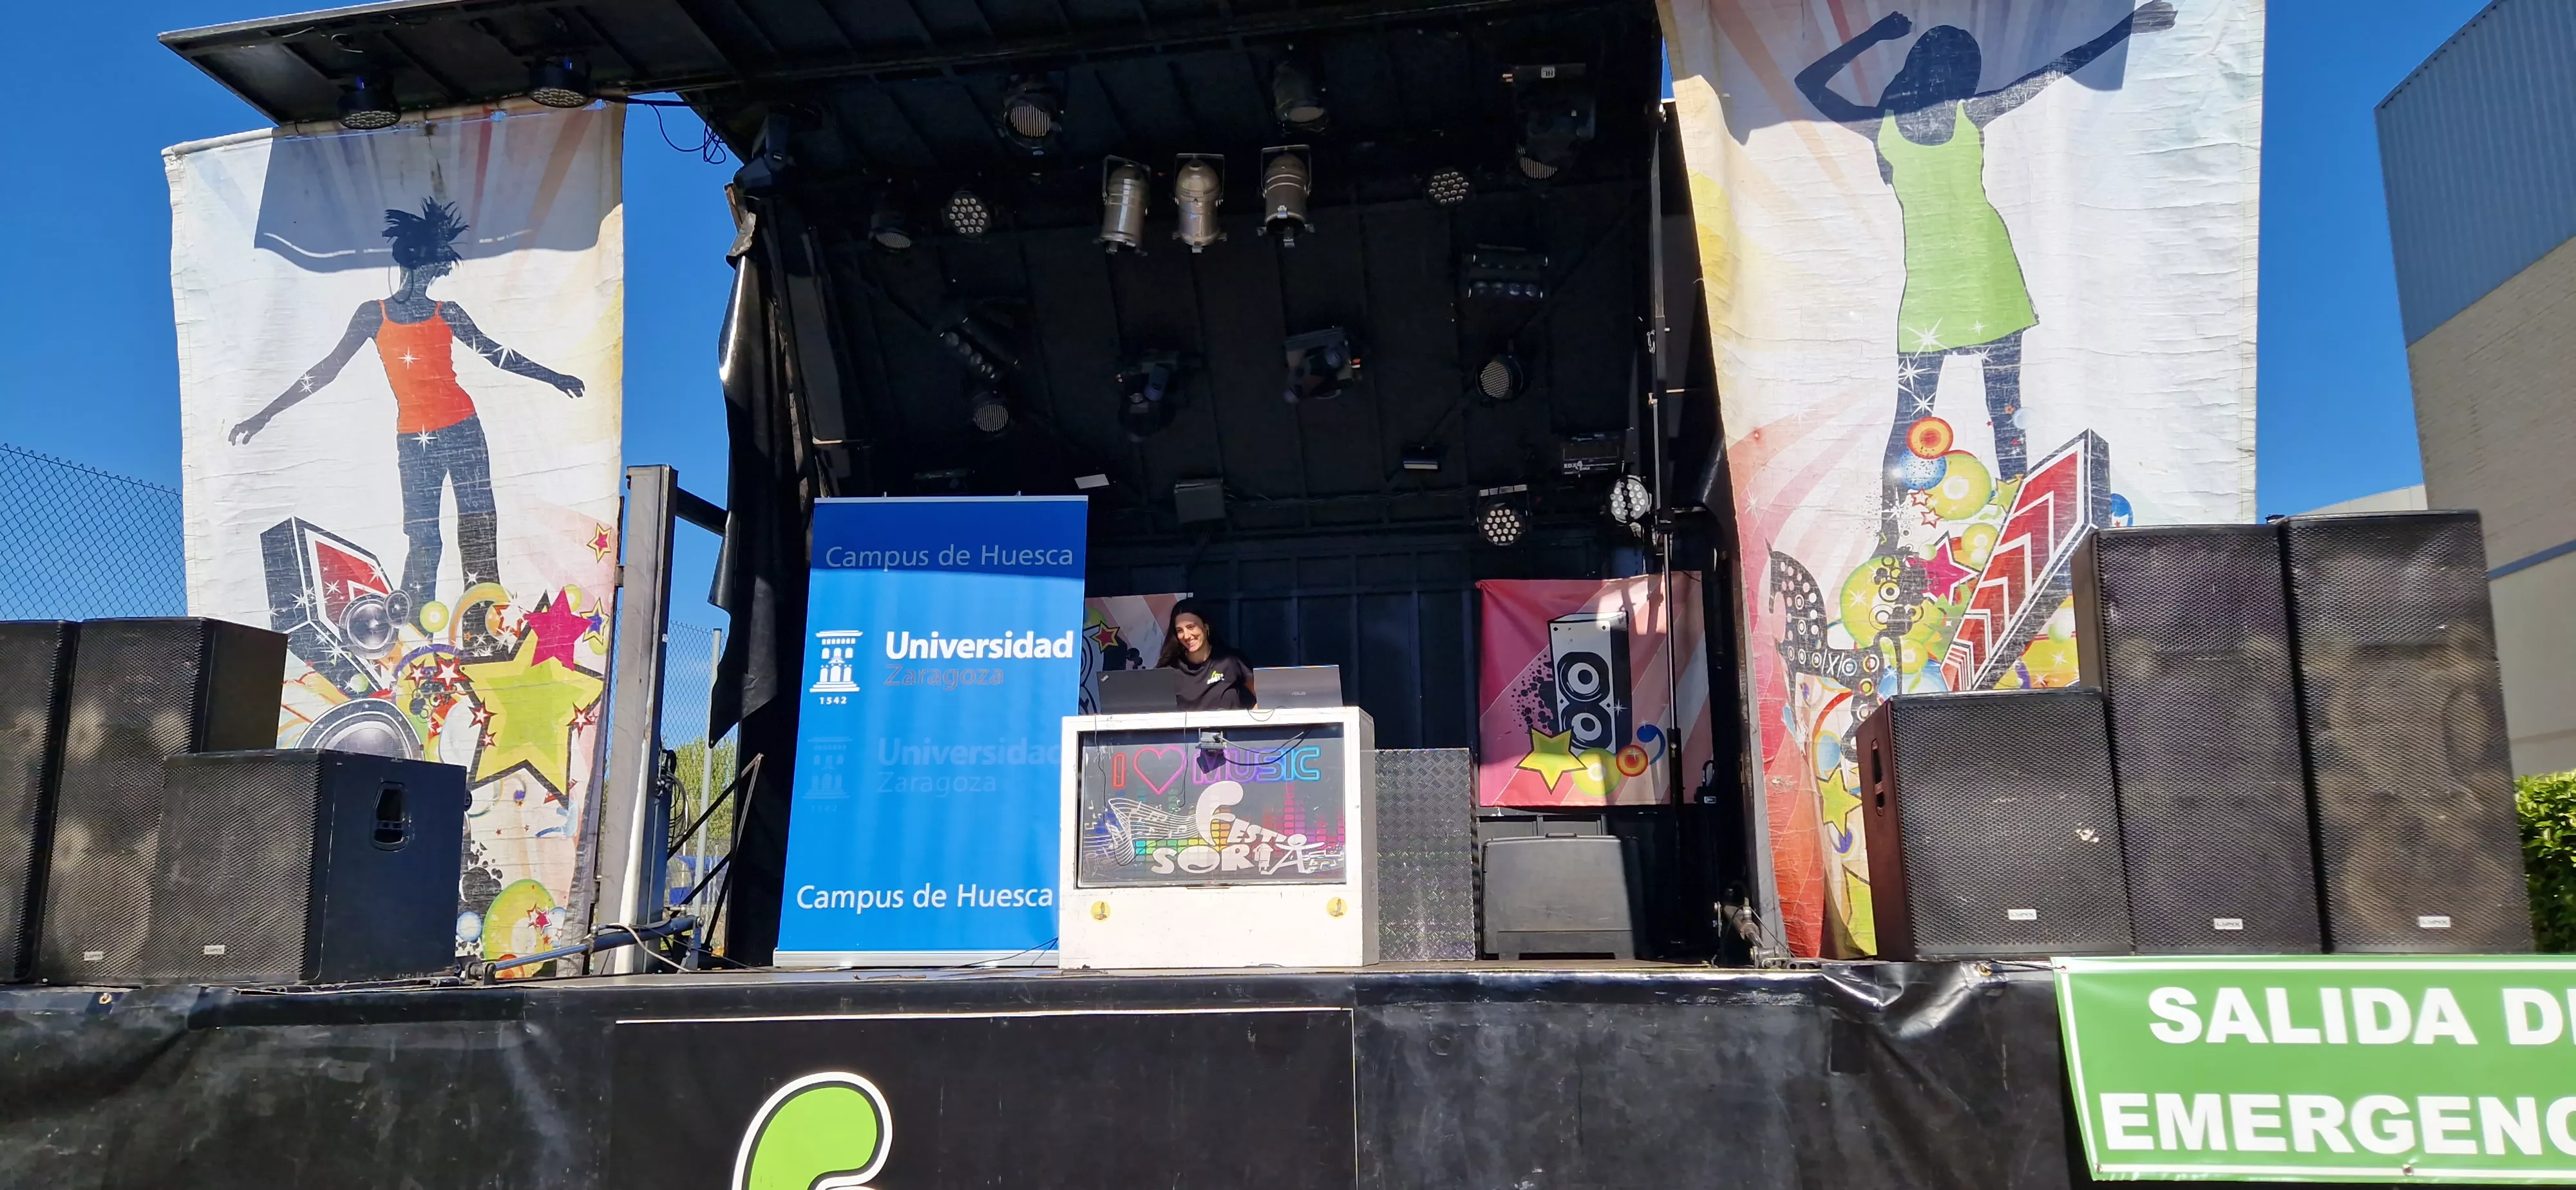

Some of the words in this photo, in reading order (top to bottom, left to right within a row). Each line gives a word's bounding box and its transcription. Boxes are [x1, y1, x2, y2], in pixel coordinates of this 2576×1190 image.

[826, 546, 929, 572] Campus
[938, 543, 971, 566] de
[981, 544, 1073, 566] Huesca
[886, 630, 1074, 659] Universidad
[884, 664, 1003, 691] Zaragoza
[819, 695, 848, 705] 1542
[1191, 745, 1321, 785] MUSIC
[876, 771, 996, 798] Zaragoza
[796, 884, 904, 914] Campus
[913, 883, 947, 908] de
[957, 883, 1053, 907] Huesca
[2148, 987, 2478, 1045] SALIDA
[2501, 988, 2576, 1045] D
